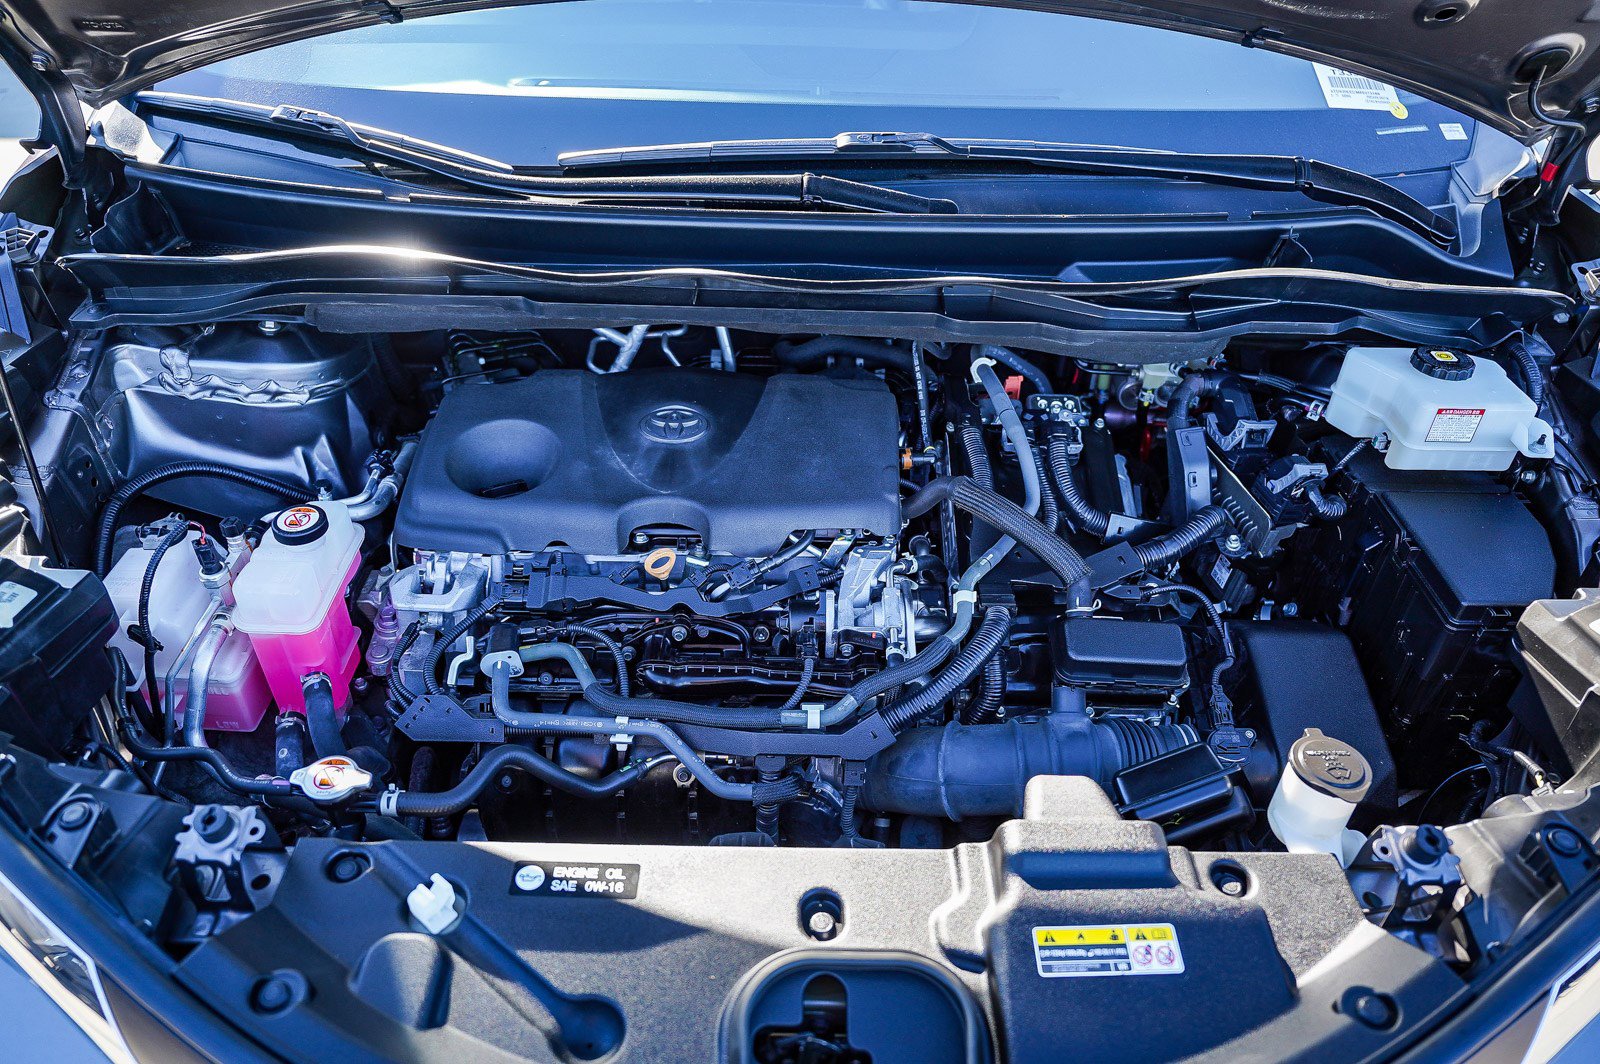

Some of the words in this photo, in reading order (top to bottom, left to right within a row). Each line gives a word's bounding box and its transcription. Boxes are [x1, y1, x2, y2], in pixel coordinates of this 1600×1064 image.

[553, 866, 600, 879] ENGINE
[604, 868, 627, 880] OIL
[550, 880, 577, 892] SAE
[584, 881, 625, 893] 0W-16
